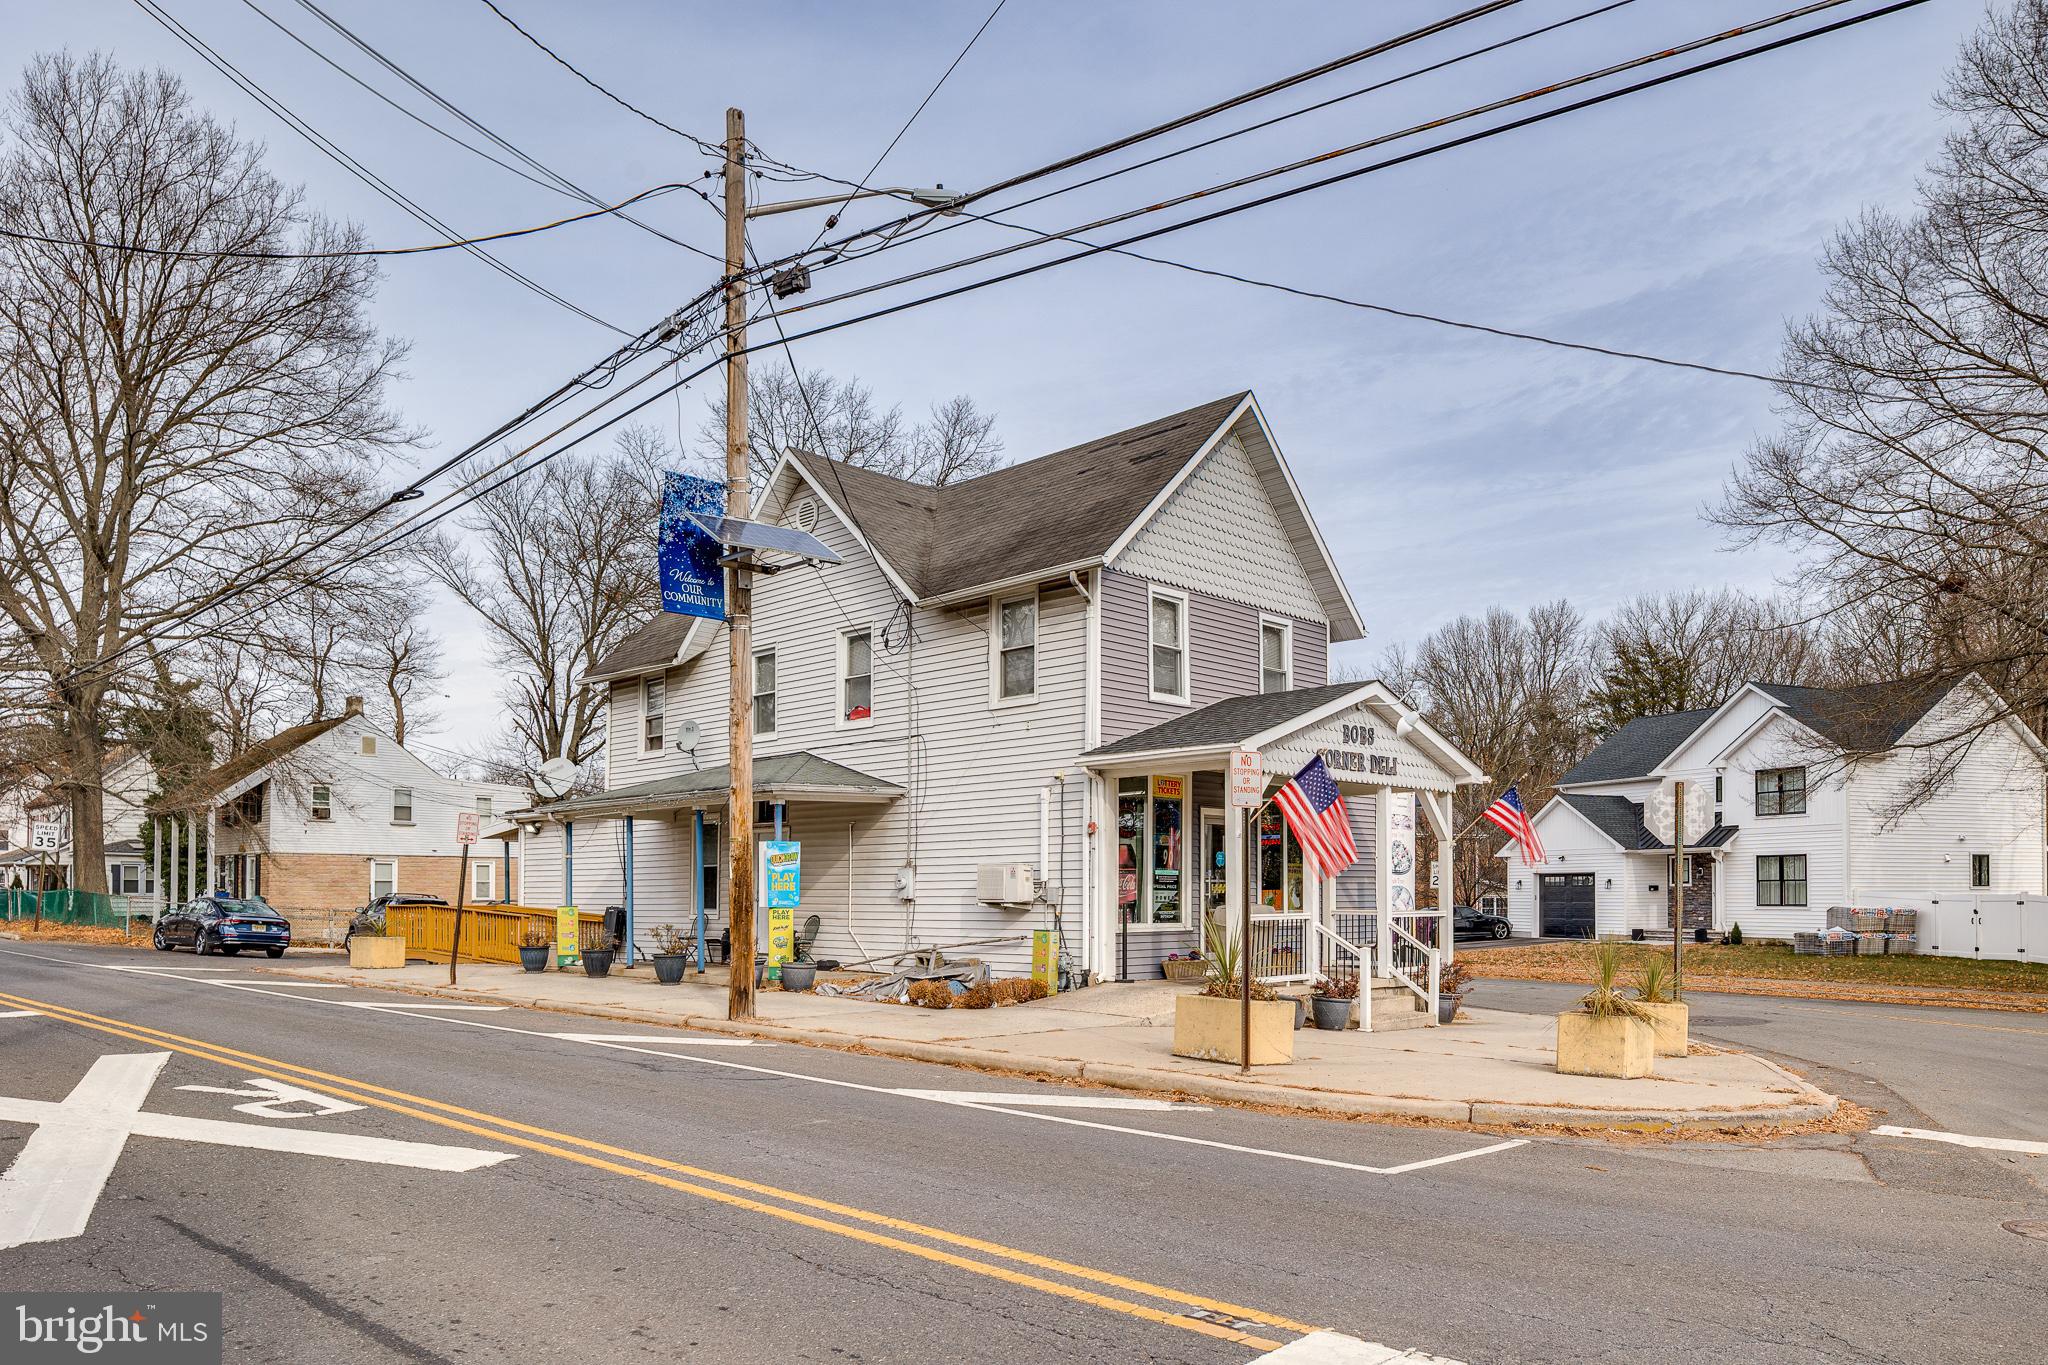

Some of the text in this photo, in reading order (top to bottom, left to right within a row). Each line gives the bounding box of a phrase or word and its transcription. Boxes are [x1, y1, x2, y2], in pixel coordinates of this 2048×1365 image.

[670, 568, 715, 586] Welcome to
[681, 583, 704, 596] OUR
[664, 590, 723, 608] COMMUNITY
[1342, 724, 1375, 745] BOBS
[1240, 756, 1252, 767] NO
[1324, 749, 1398, 775] ORNER DELI
[1233, 768, 1260, 776] STOPPING
[1157, 779, 1182, 788] LOTTERY
[1242, 777, 1251, 785] OR
[1158, 787, 1181, 796] TICKETS
[1233, 786, 1260, 794] STANDING
[34, 836, 56, 848] 35
[772, 873, 796, 882] PLAY
[771, 882, 796, 891] HERE
